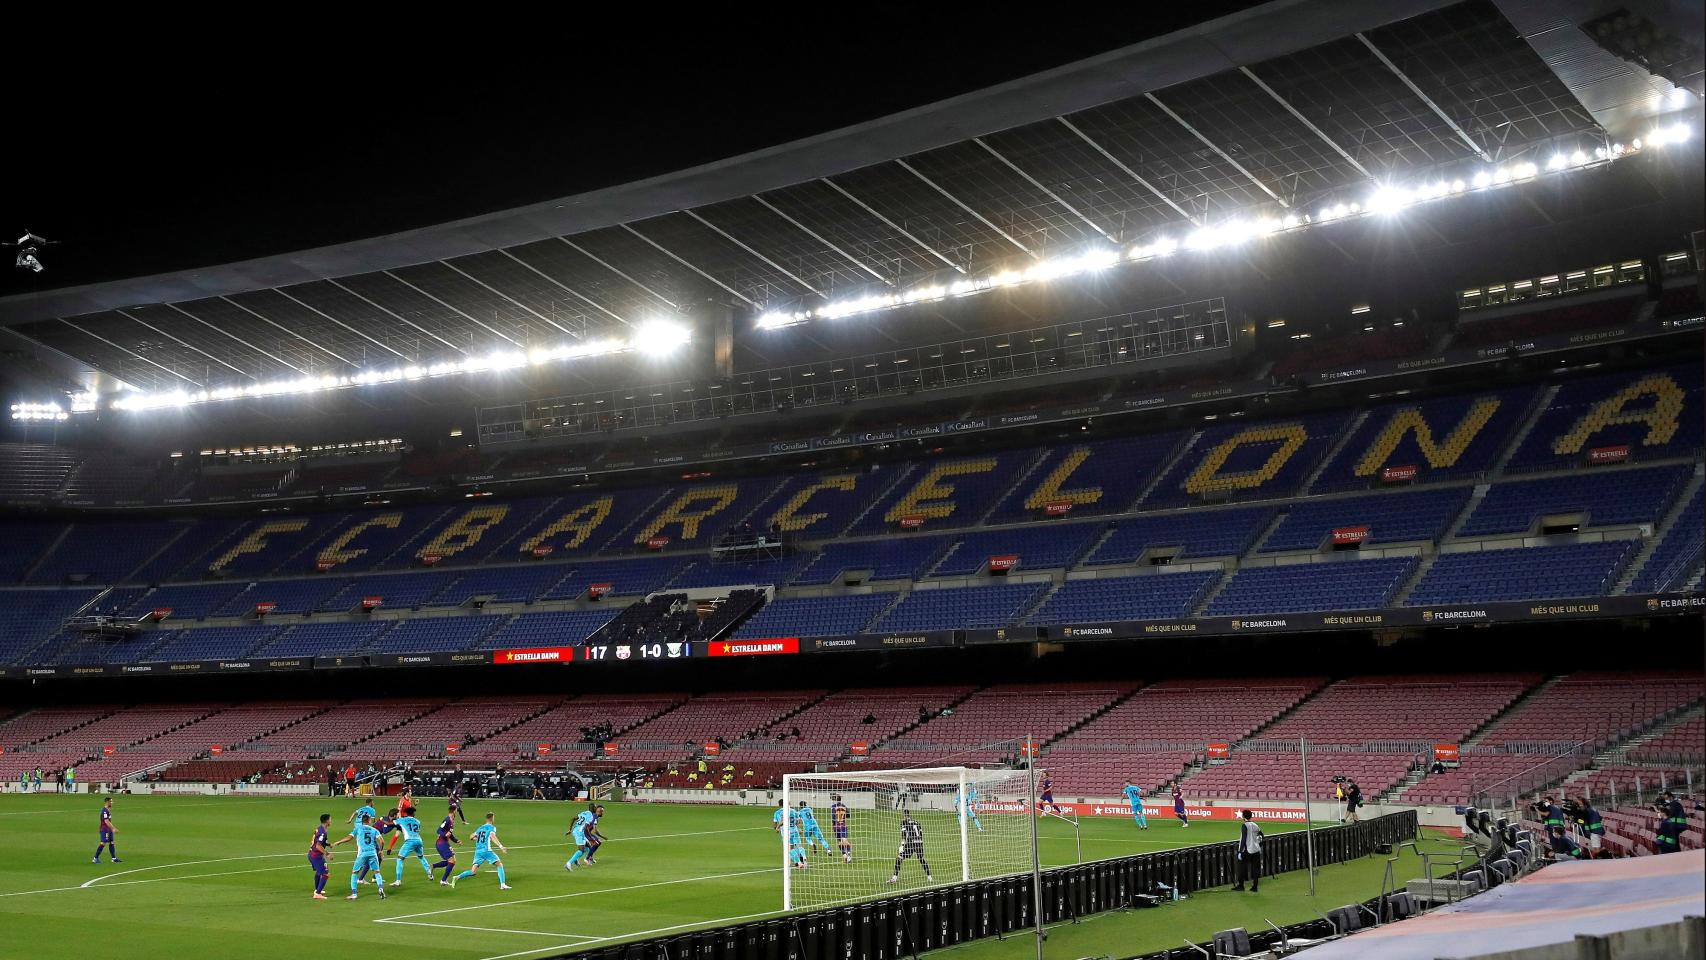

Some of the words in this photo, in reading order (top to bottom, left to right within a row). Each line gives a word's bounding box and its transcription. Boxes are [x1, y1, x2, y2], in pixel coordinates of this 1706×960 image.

[1531, 605, 1547, 614] MÉS
[1549, 606, 1565, 614] QUE
[1566, 605, 1578, 613] UN
[1579, 604, 1599, 612] CLUB
[1444, 610, 1486, 619] BARCELONA
[1339, 616, 1353, 624] QUE
[591, 645, 608, 660] 17
[640, 643, 662, 658] 1-0
[731, 644, 760, 653] ESTRELLA
[761, 643, 784, 652] DAMM
[514, 652, 541, 660] ESTRELLA
[541, 651, 560, 660] DAMM
[1282, 811, 1306, 819] DAMM
[407, 822, 419, 833] 12
[364, 832, 371, 845] 5
[477, 831, 486, 843] 15
